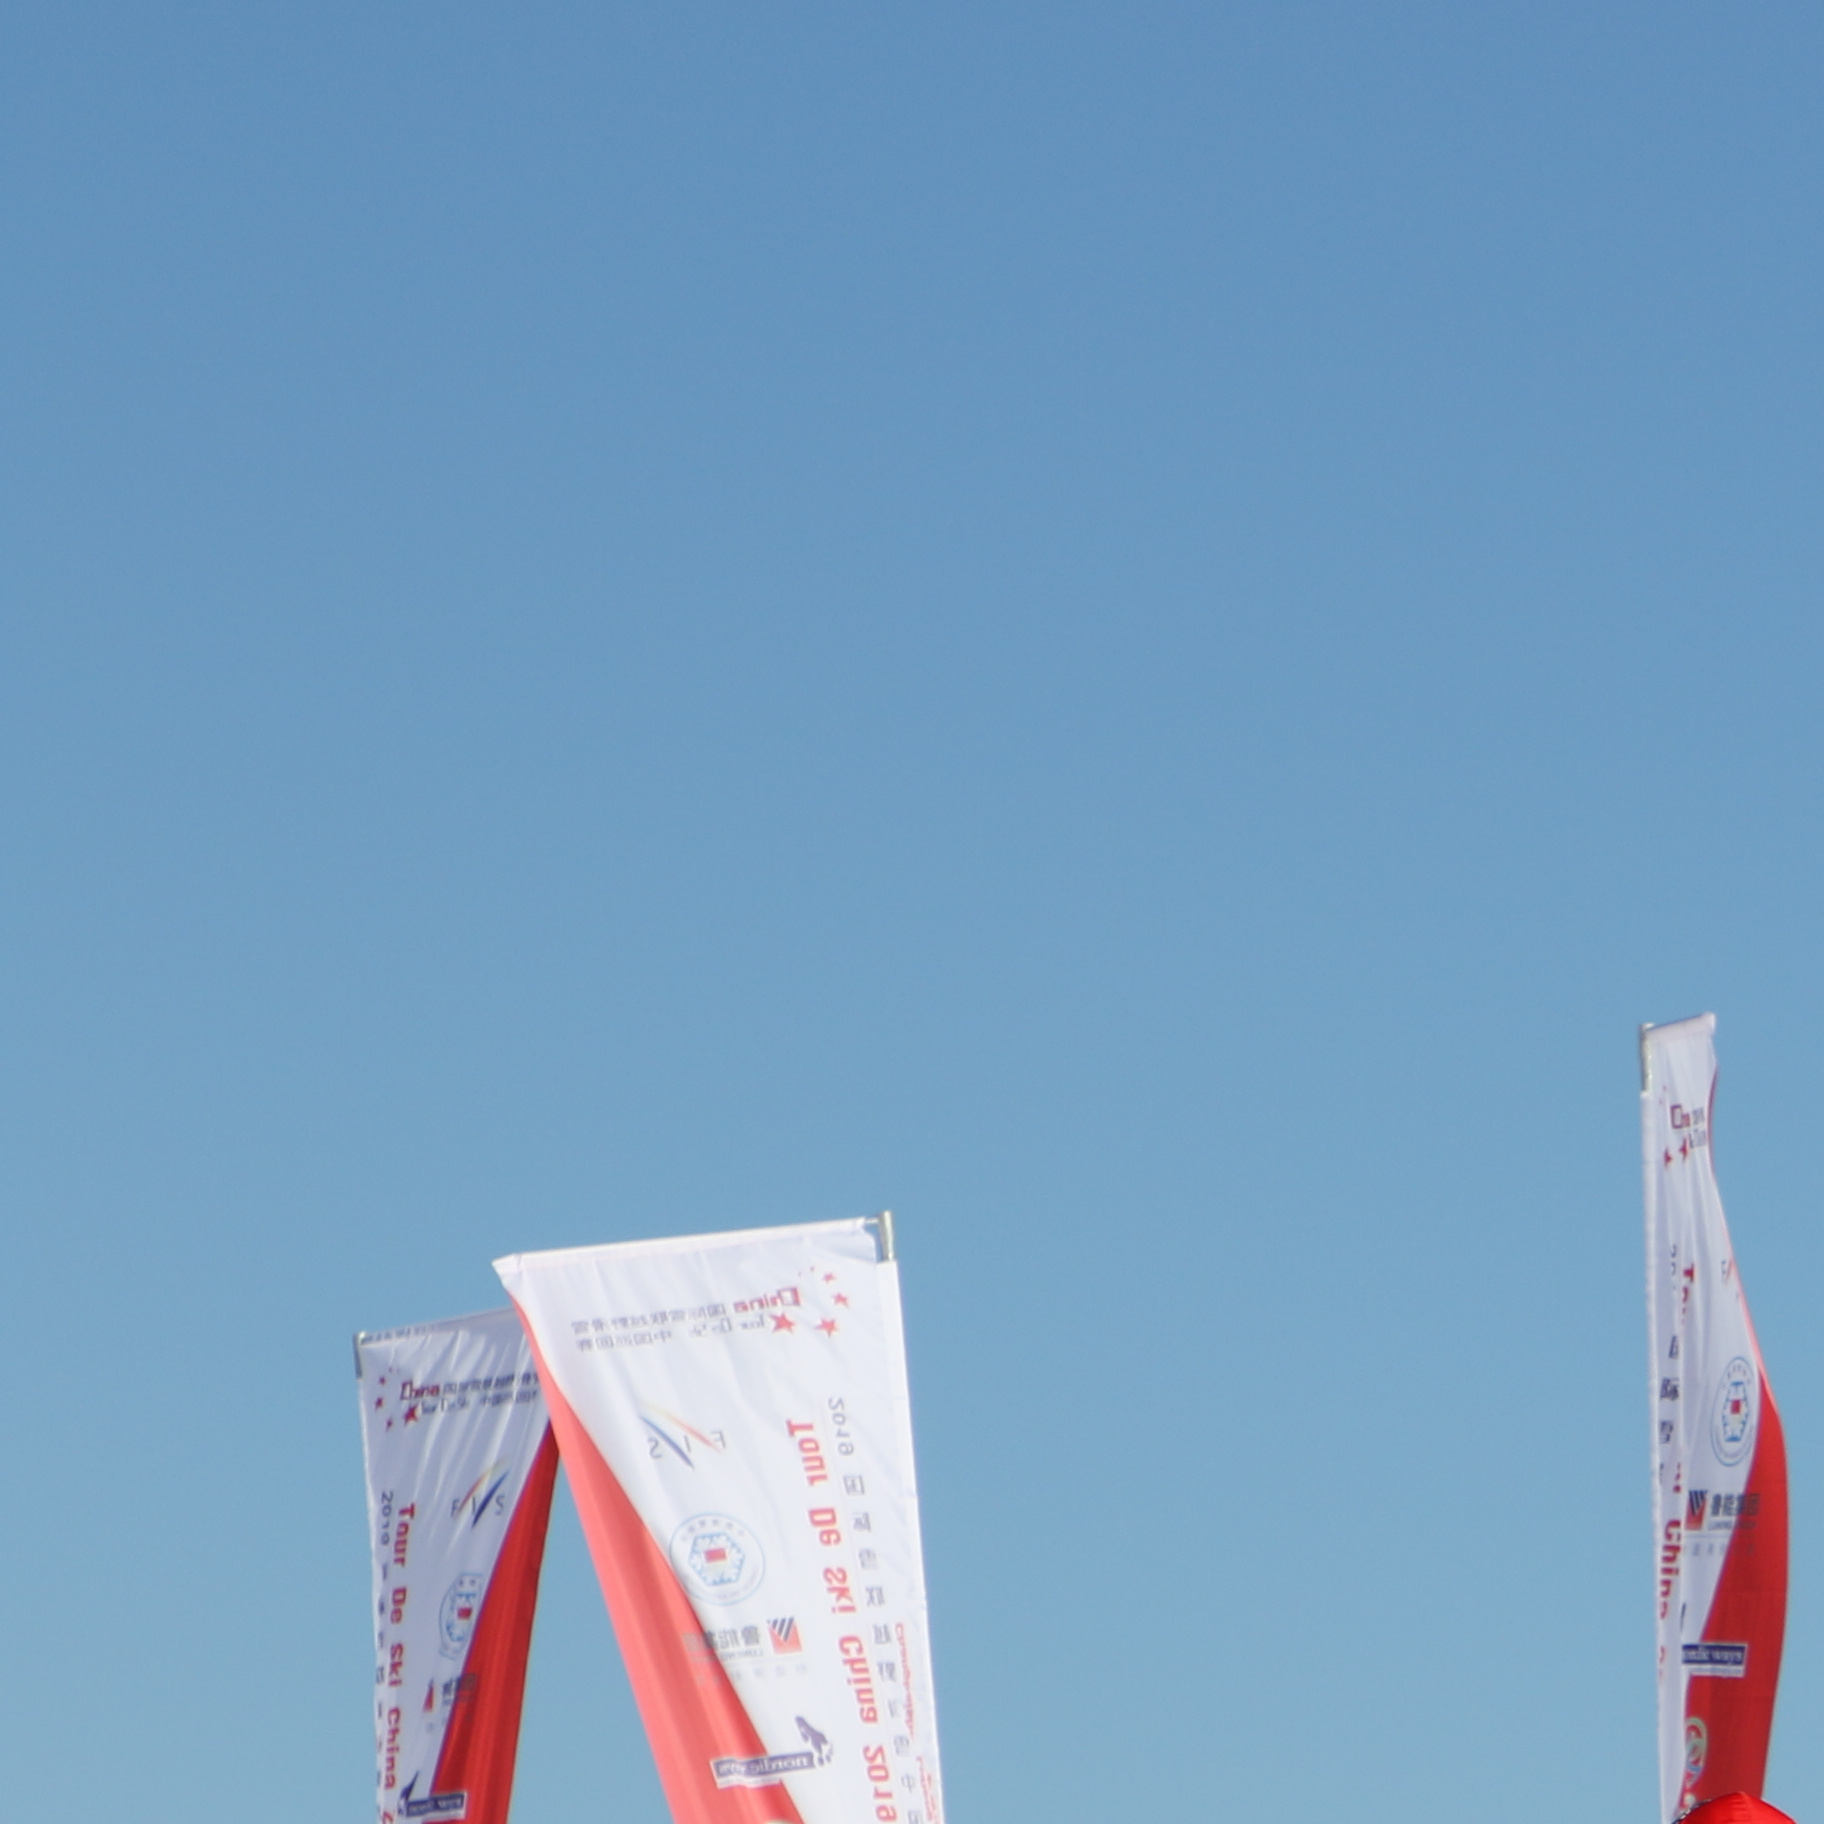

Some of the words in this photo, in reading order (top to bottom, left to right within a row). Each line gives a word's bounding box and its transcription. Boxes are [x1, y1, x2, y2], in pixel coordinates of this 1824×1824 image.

[393, 1503, 415, 1568] Tour
[390, 1587, 407, 1625] De
[388, 1643, 405, 1688] Ski
[384, 1706, 402, 1791] China
